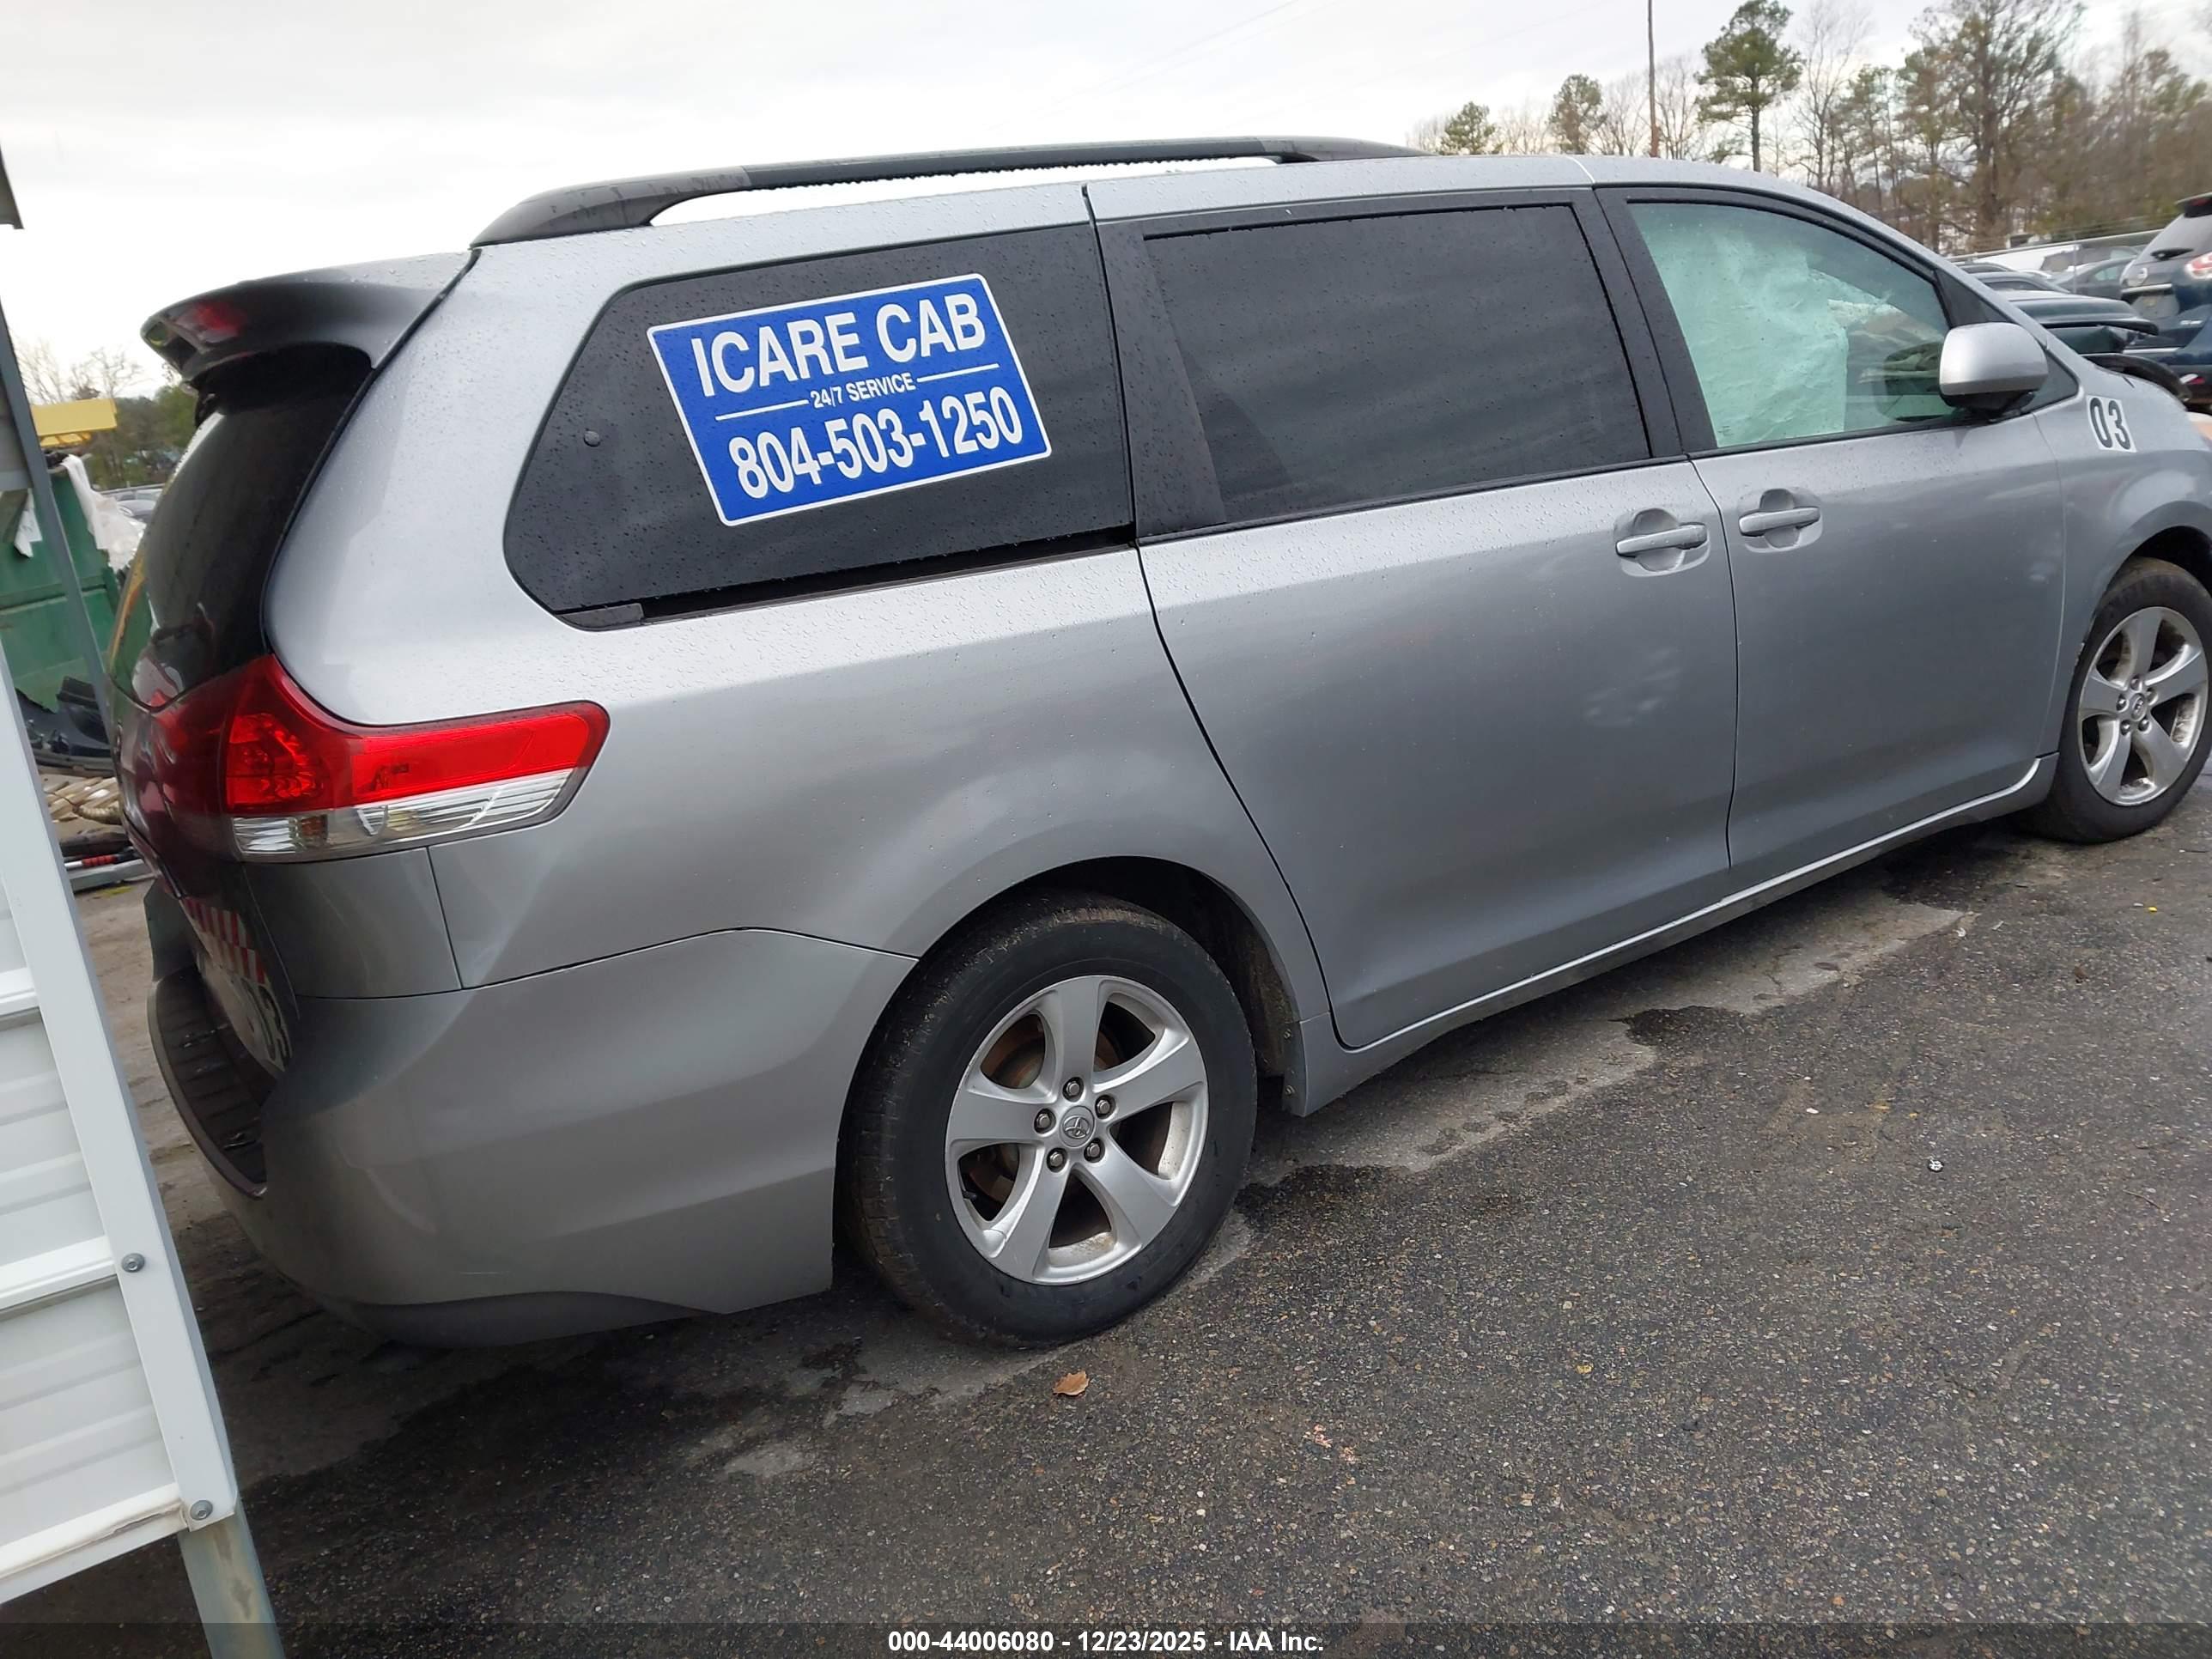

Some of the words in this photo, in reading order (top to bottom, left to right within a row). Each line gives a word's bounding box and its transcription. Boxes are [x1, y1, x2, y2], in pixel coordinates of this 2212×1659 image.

[690, 312, 869, 398] ICARE
[876, 293, 986, 363] CAB
[810, 386, 844, 409] 24/7
[847, 372, 916, 402] SERVICE
[2089, 397, 2131, 450] 03
[728, 386, 1023, 499] 804-503-1250
